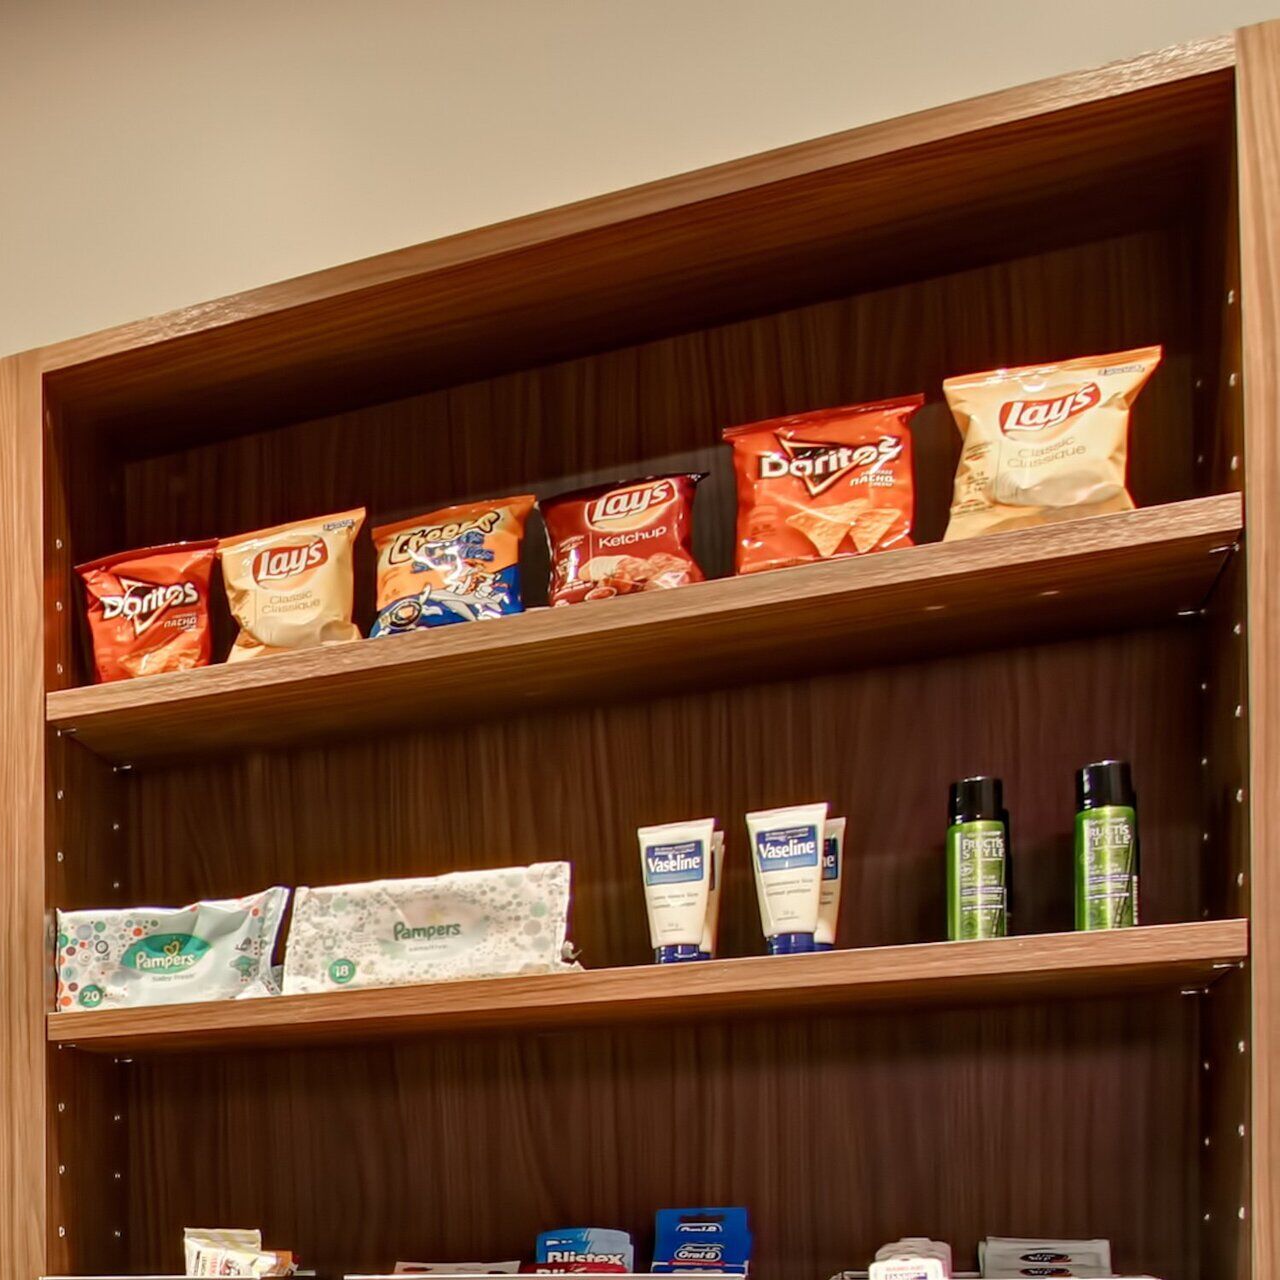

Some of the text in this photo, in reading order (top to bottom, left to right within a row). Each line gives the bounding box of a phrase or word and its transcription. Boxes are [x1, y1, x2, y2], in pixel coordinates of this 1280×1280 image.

[1007, 445, 1088, 468] Classique
[1018, 437, 1075, 457] Classic
[759, 435, 903, 480] Doritos
[598, 525, 667, 549] Ketchup
[100, 581, 199, 621] Doritos
[261, 598, 321, 616] Classique
[269, 590, 313, 606] Classic
[758, 840, 815, 860] Vaseline
[647, 854, 701, 873] Vaseline
[393, 921, 461, 941] Pampers
[135, 951, 195, 970] Pampers
[335, 965, 350, 977] 18
[83, 991, 100, 1002] 20
[547, 1251, 624, 1265] Blistex
